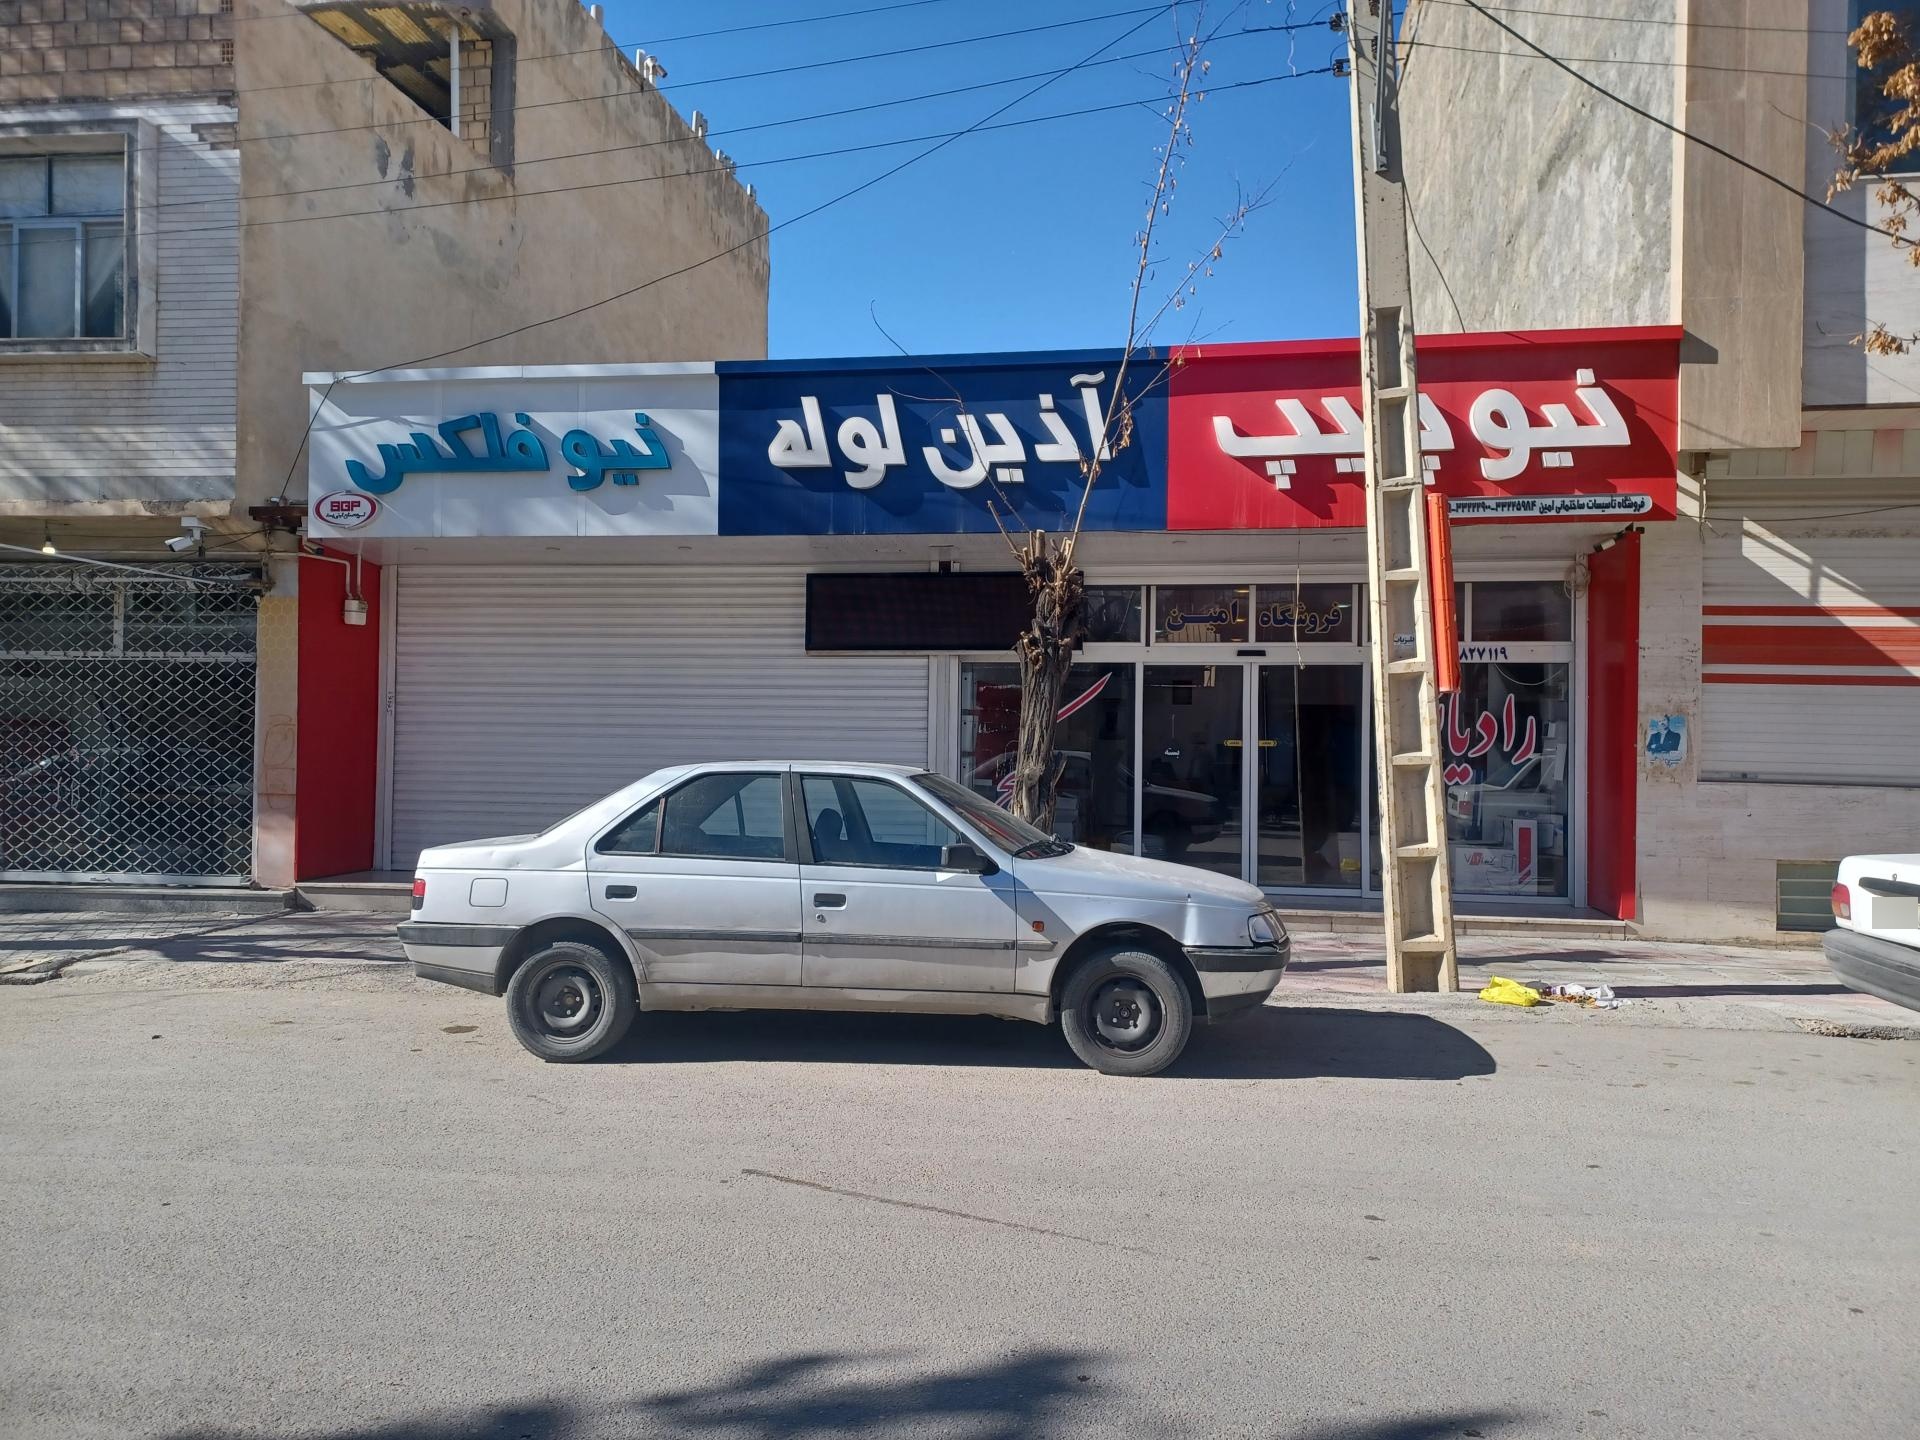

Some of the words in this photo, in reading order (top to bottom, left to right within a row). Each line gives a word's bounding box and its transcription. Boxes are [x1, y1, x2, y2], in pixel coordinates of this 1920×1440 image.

[345, 412, 550, 494] فلکس
[562, 412, 672, 491] نیو
[767, 394, 905, 490] لوله
[923, 371, 1112, 490] آذین
[1469, 368, 1631, 481] نیو
[1539, 500, 1555, 514] امین
[1555, 498, 1586, 514] ساختمانی
[1617, 496, 1646, 513] فروشگاه
[1165, 598, 1240, 634] امین
[1258, 601, 1343, 634] فروشگاه
